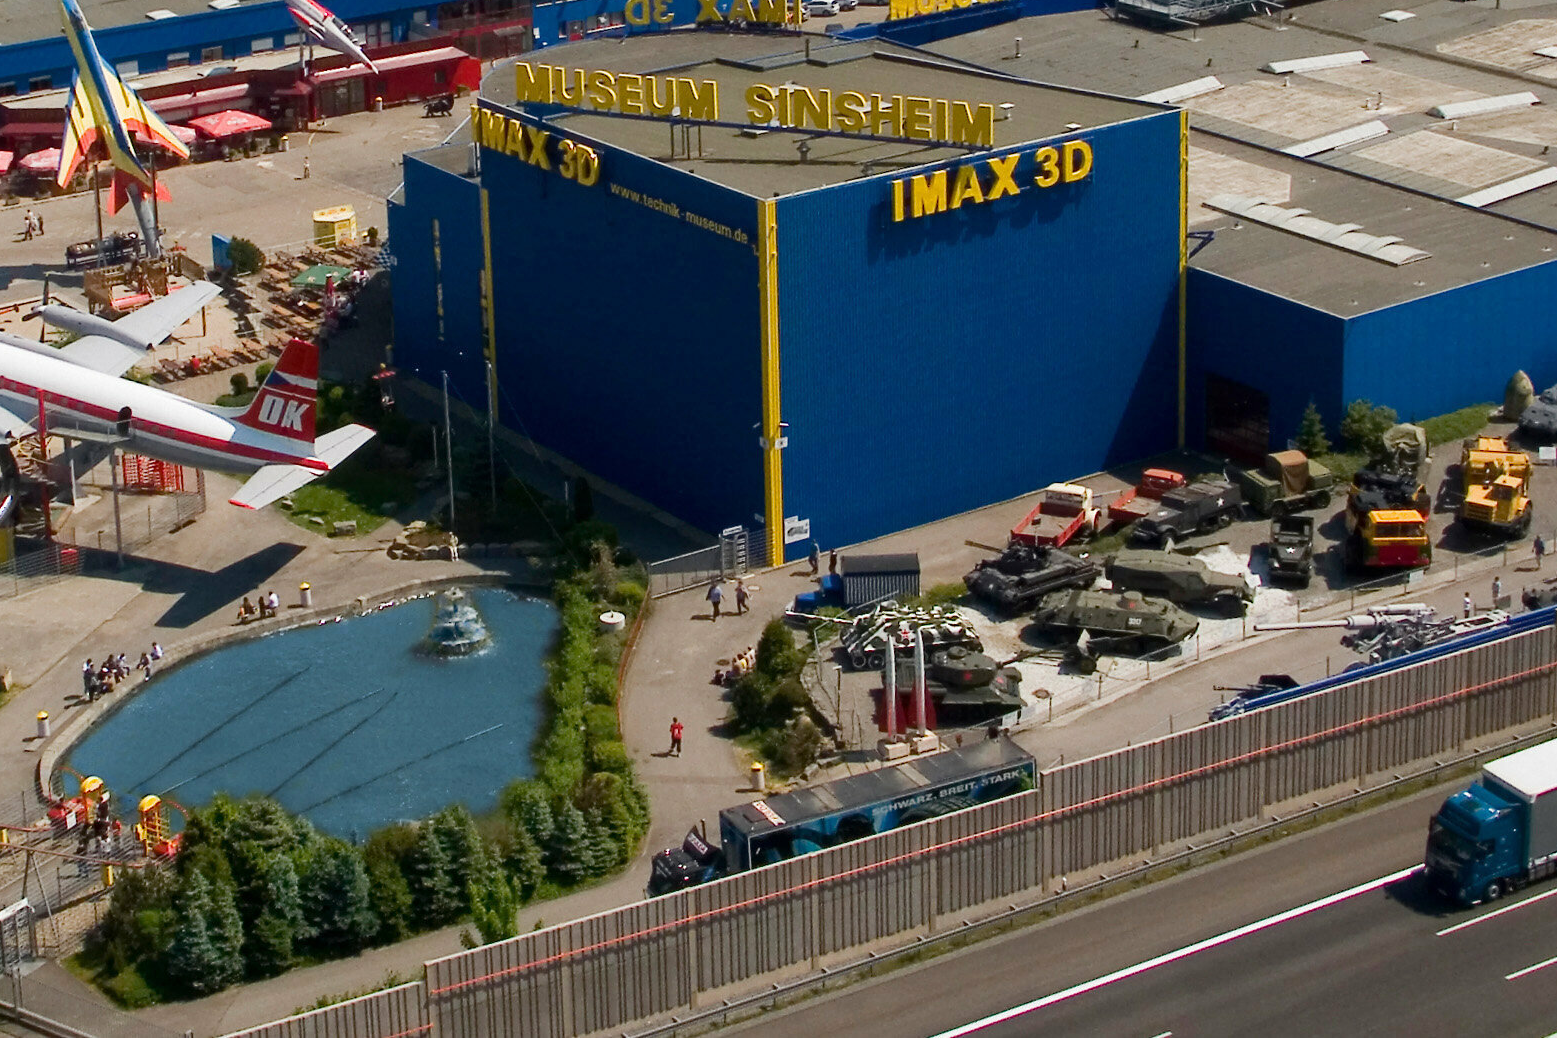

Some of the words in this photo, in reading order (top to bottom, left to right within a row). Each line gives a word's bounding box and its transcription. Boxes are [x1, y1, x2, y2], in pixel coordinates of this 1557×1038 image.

[469, 103, 551, 171] IMAX
[557, 138, 601, 187] 3D
[515, 62, 719, 122] MUSEUM
[745, 83, 995, 147] SINSHEIM
[891, 153, 1021, 223] IMAX
[1033, 139, 1094, 189] 3D
[257, 393, 310, 433] OK
